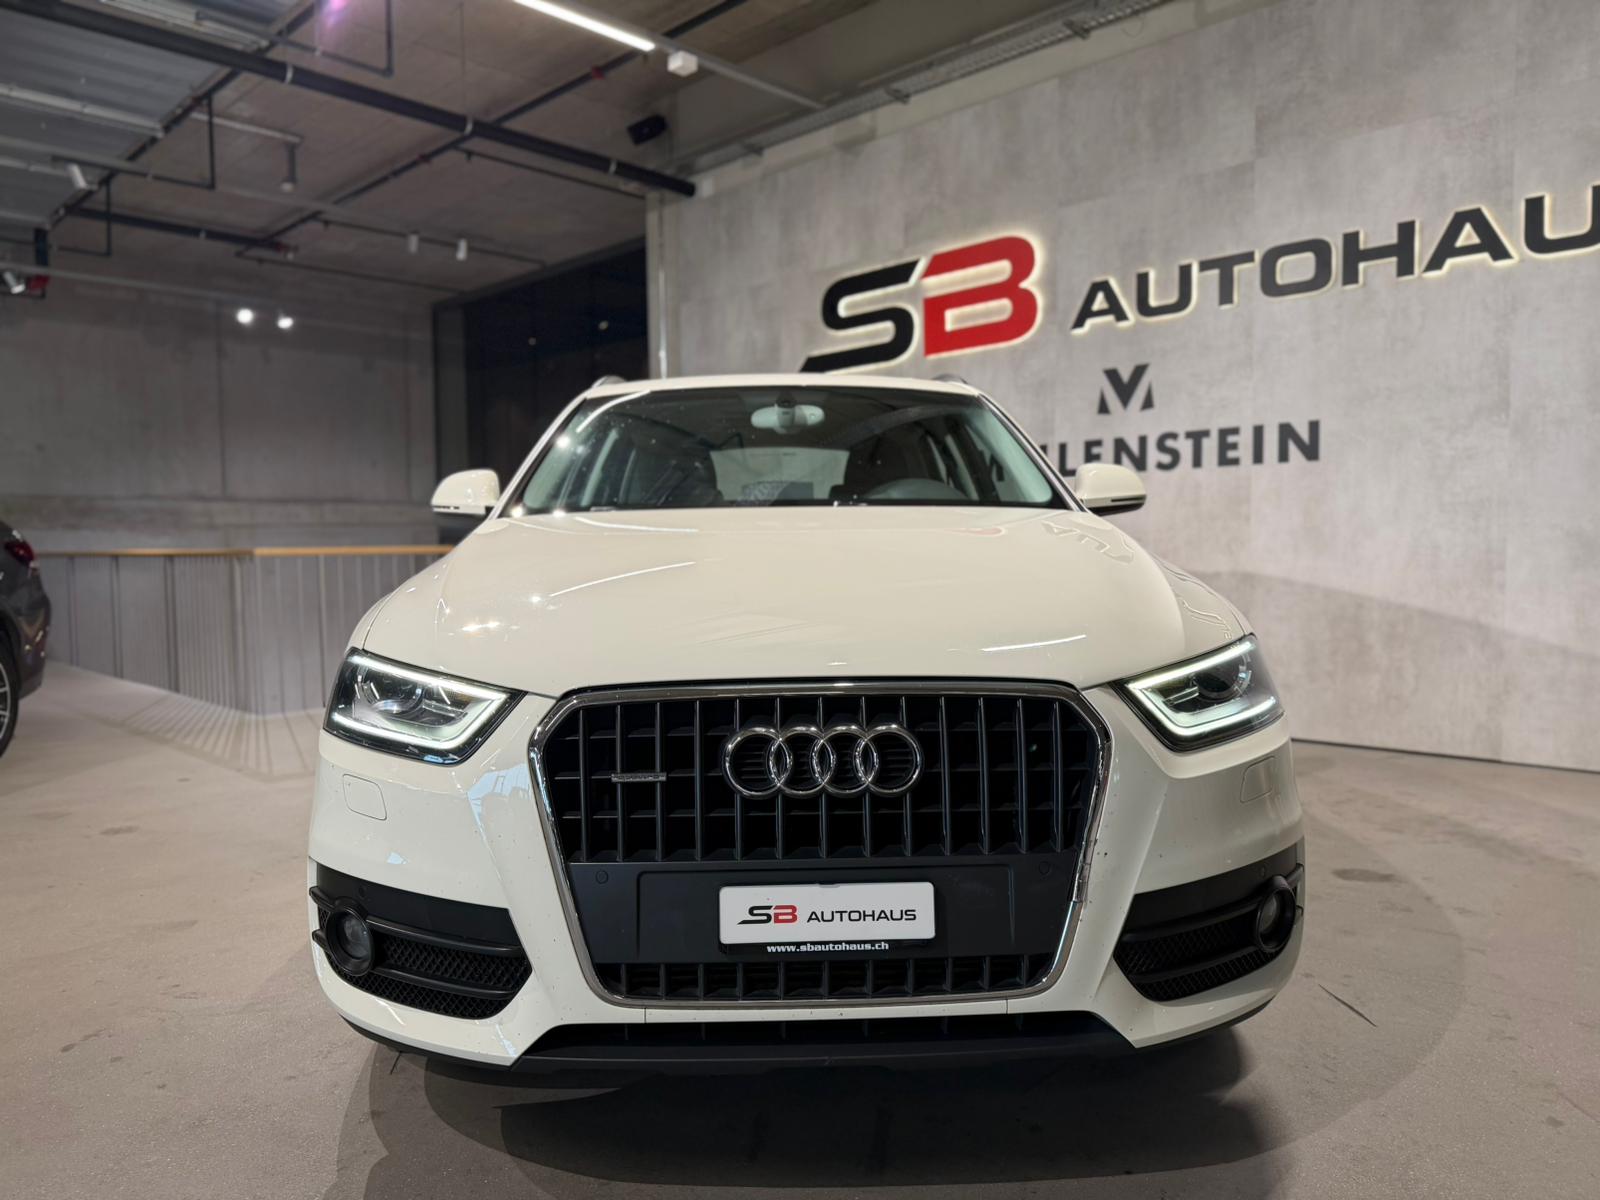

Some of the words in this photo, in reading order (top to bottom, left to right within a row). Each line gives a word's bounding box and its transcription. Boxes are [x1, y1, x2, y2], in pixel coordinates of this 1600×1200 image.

[799, 235, 1040, 373] SB
[1071, 184, 1600, 332] AUTOHAU
[1038, 419, 1320, 478] LENSTEIN
[736, 904, 798, 925] SB
[806, 908, 918, 924] AUTOHAUS
[766, 941, 890, 954] www.sbautohaus.ch
